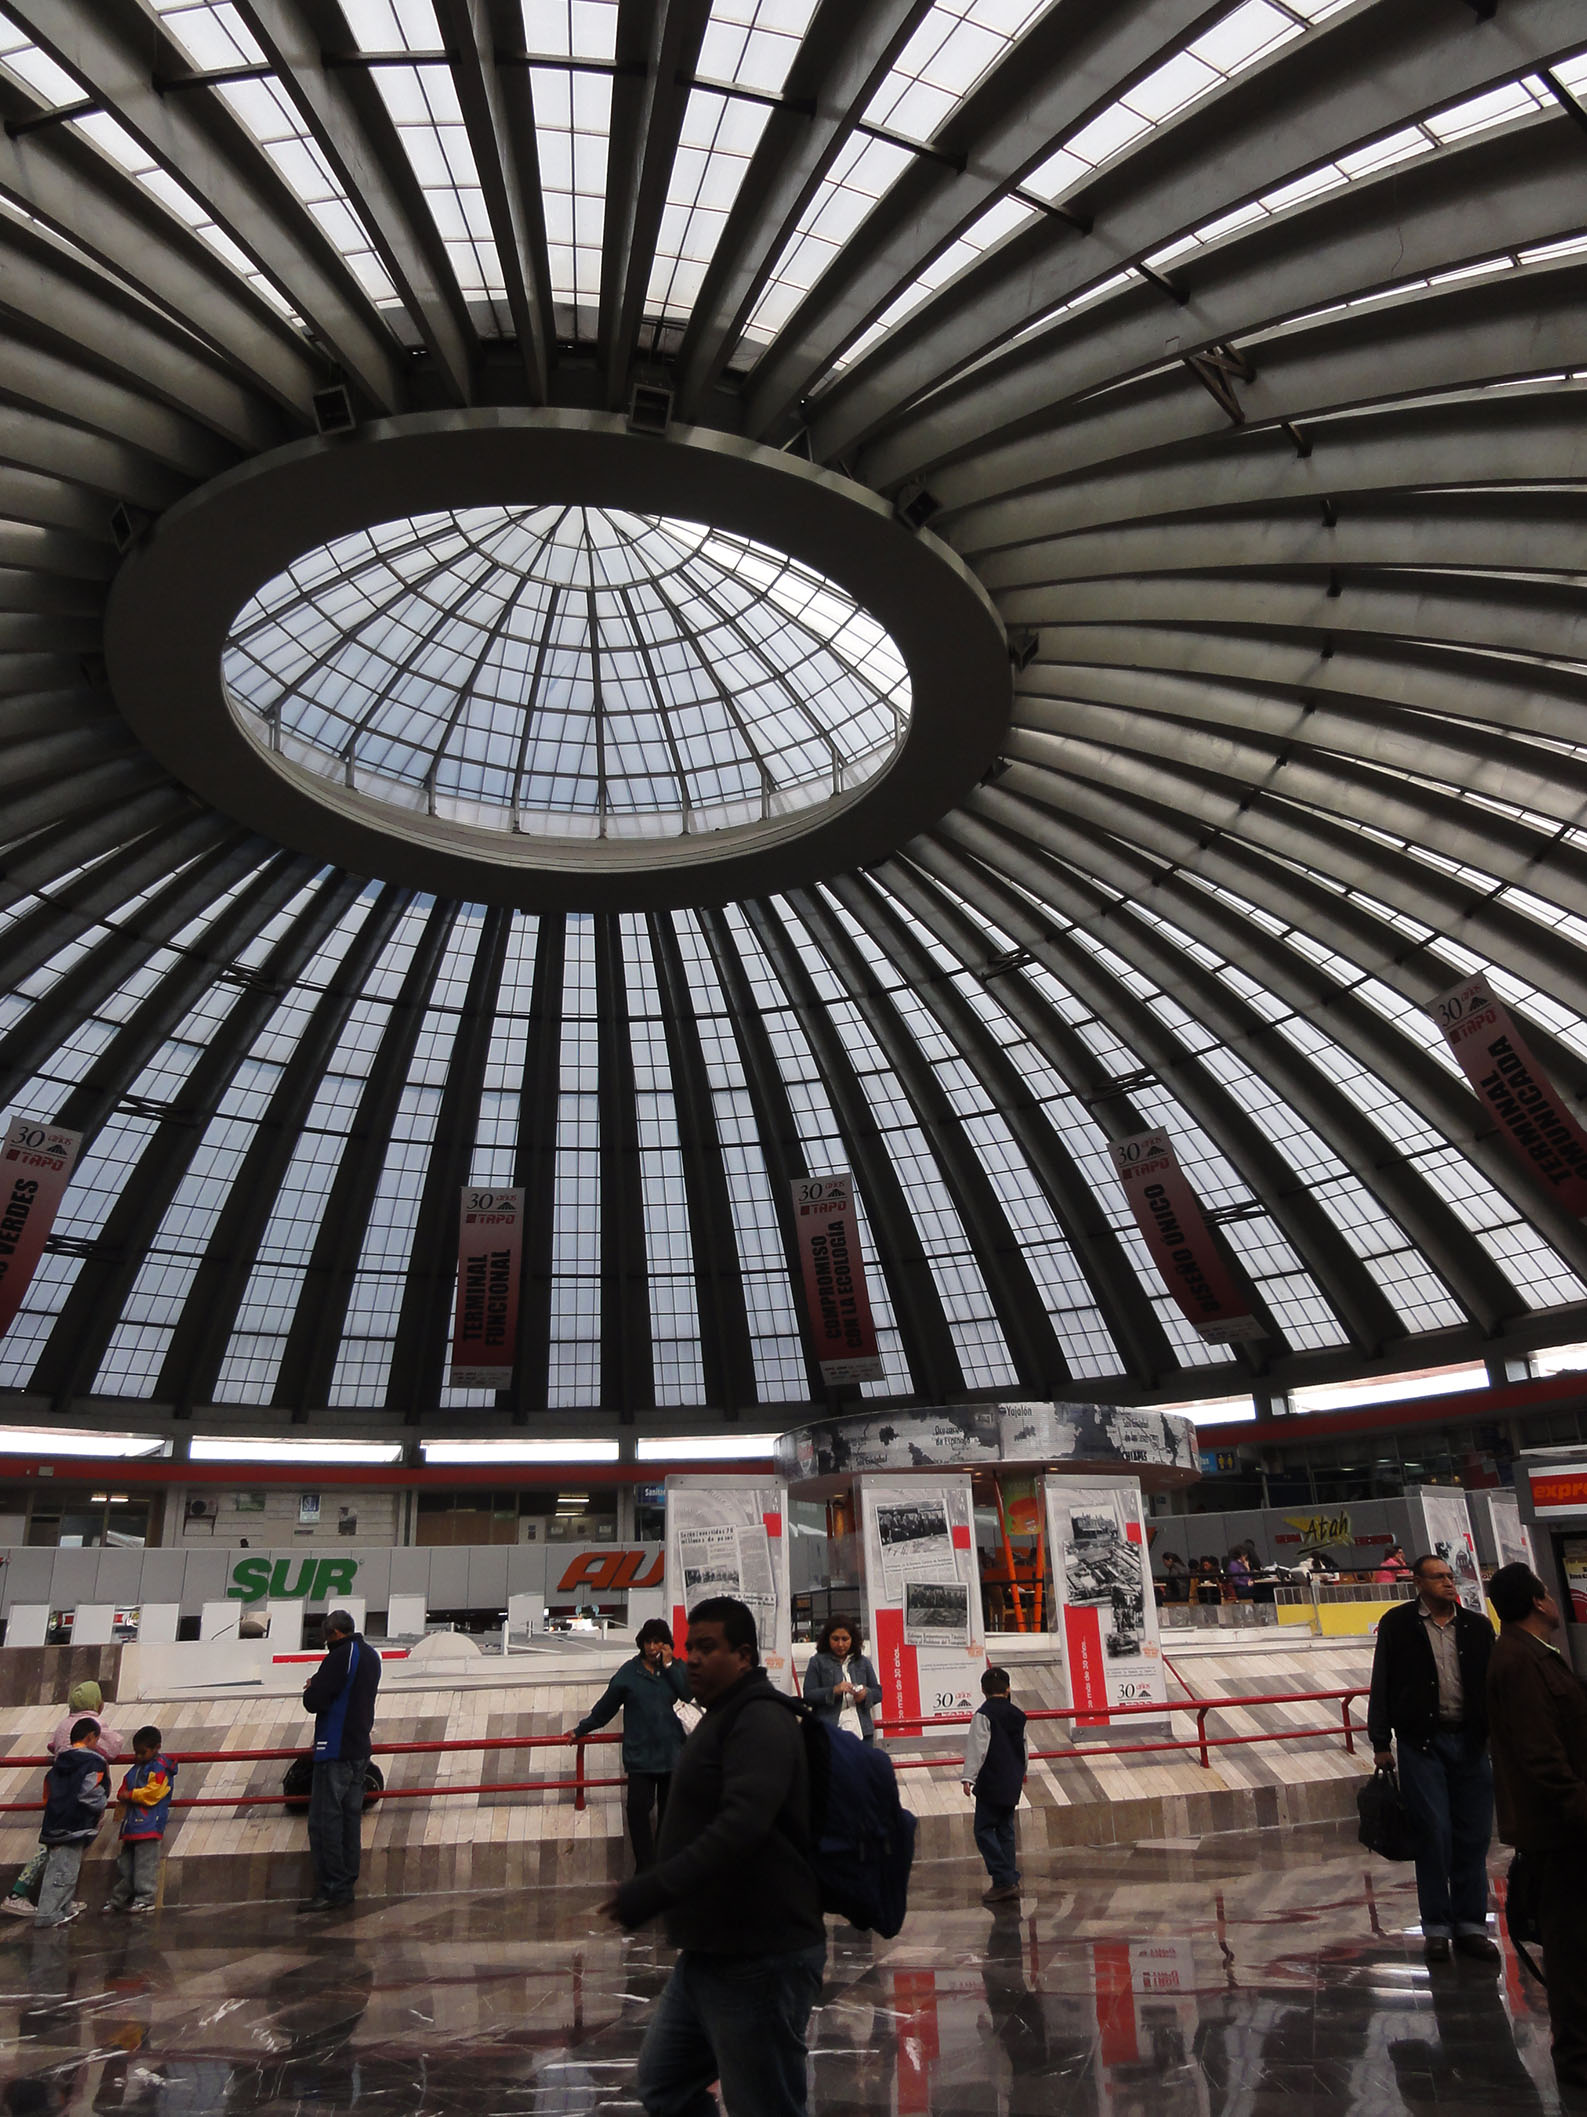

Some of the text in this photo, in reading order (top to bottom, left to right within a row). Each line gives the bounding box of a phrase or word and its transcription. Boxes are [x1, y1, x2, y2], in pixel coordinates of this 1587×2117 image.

[1438, 997, 1463, 1027] 30
[1457, 1008, 1497, 1038] TAPO
[11, 1126, 45, 1148] 30
[1479, 1069, 1572, 1187] TERMINAL
[21, 1151, 64, 1172] TAPO
[1116, 1142, 1140, 1166] 30
[1134, 1157, 1170, 1177] TAPO
[466, 1192, 493, 1210] 30
[798, 1182, 823, 1202] 30
[811, 1200, 847, 1215] TAPO
[478, 1213, 516, 1225] TAPO
[810, 1235, 842, 1339] COMPROMISO
[826, 1220, 864, 1349] CON LA ECOLOGÍA
[463, 1253, 488, 1342] TERMINAL
[485, 1248, 511, 1347] FUNCIONAL
[1005, 1405, 1033, 1418] Yajalón
[227, 1557, 359, 1603] SUR
[557, 1549, 665, 1592] AU
[894, 1668, 901, 1679] 30
[1082, 1660, 1089, 1670] 30
[896, 1680, 903, 1691] de
[1084, 1670, 1090, 1682] de
[896, 1691, 904, 1709] más
[932, 1691, 954, 1709] 30
[1085, 1682, 1093, 1699] más
[1117, 1682, 1135, 1699] 30
